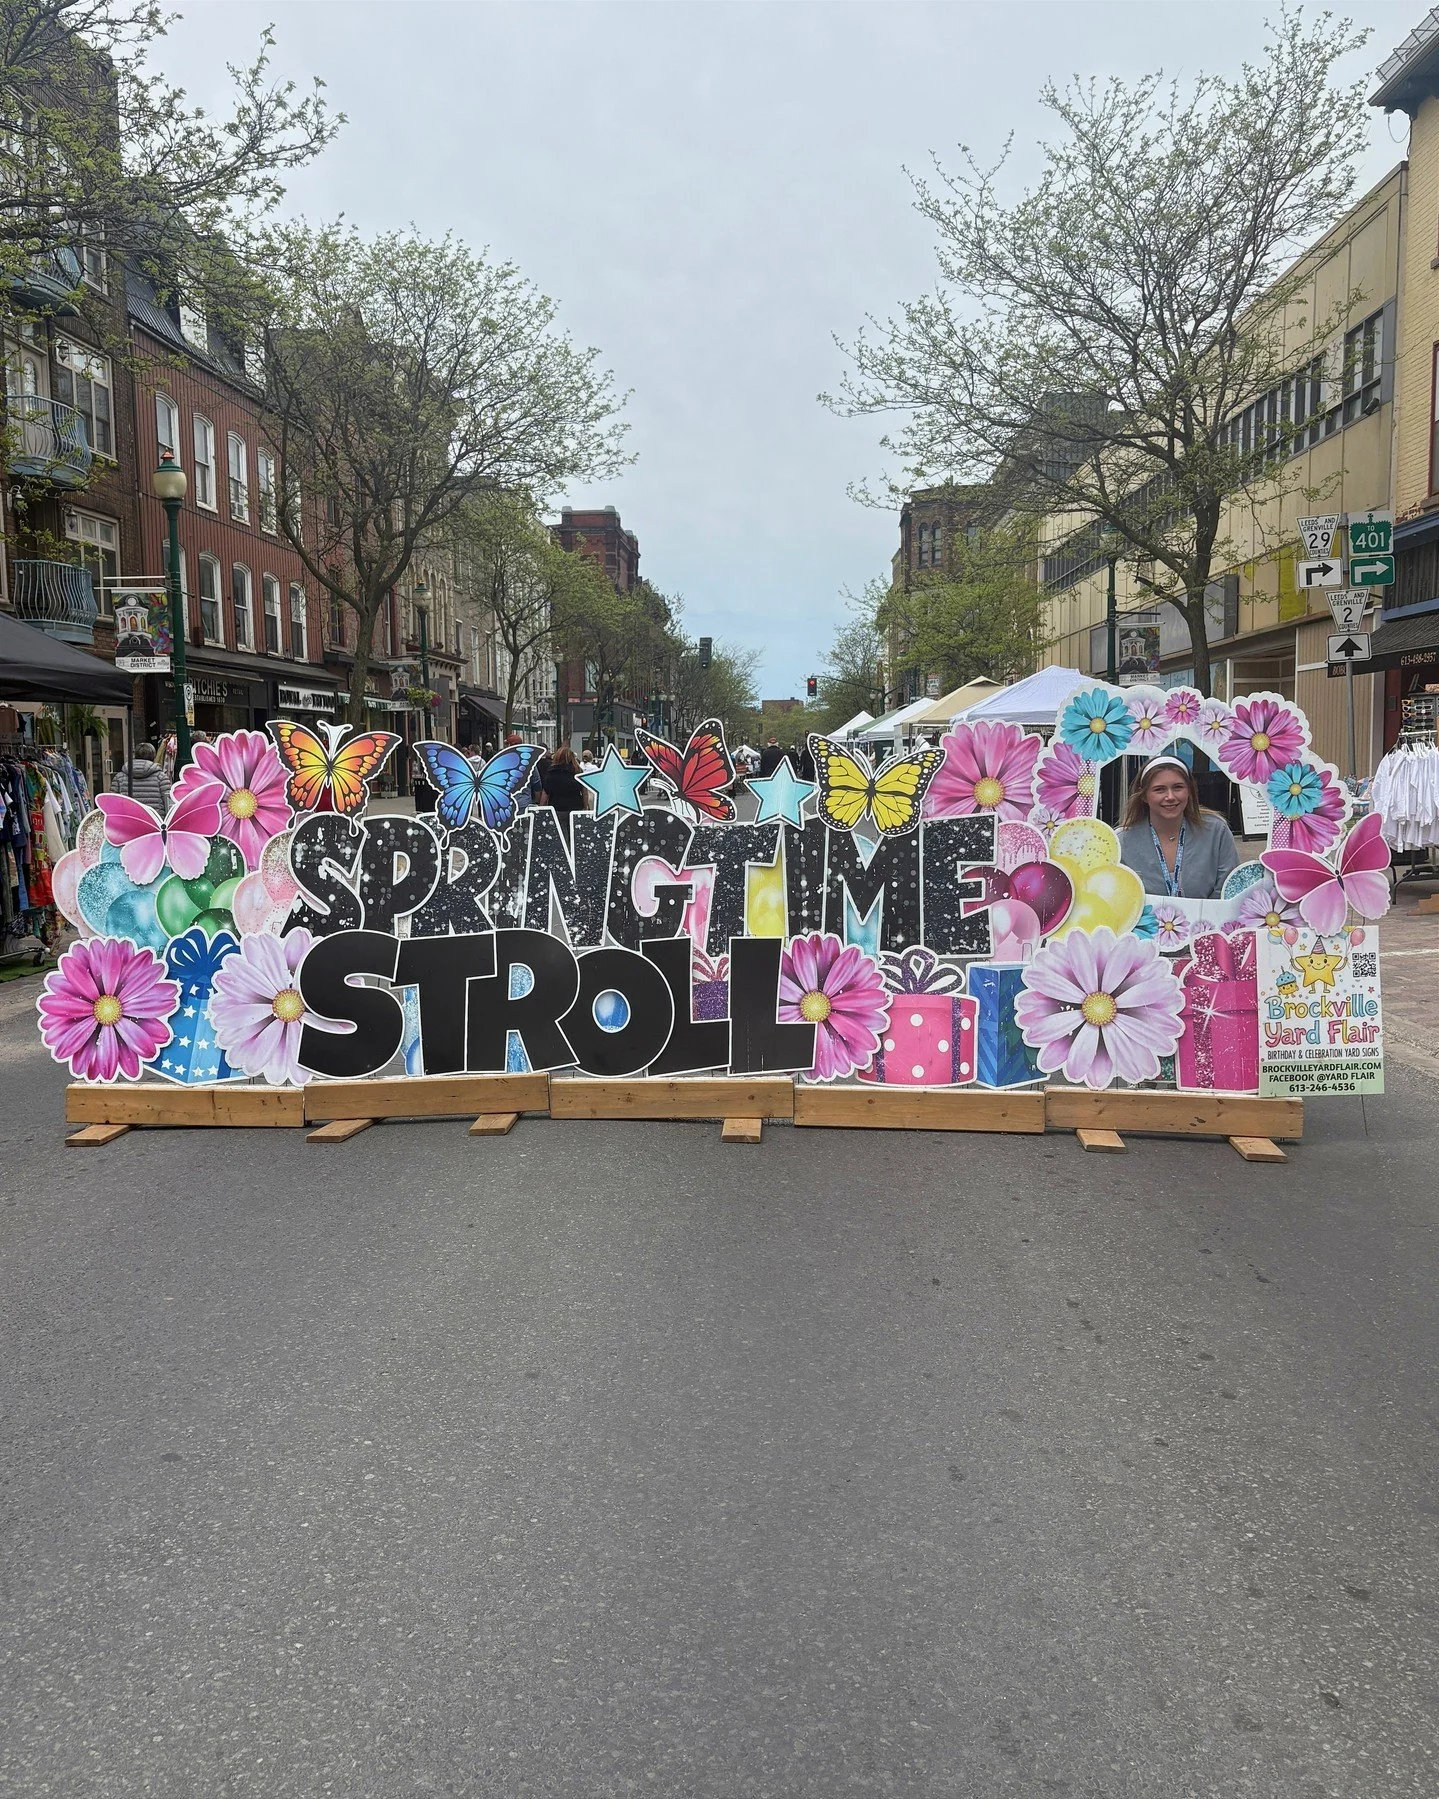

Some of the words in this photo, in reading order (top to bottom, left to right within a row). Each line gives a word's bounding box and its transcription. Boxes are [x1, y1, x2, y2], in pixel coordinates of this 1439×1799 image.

[1303, 524, 1333, 532] GRENVILLE
[1308, 532, 1330, 549] 29
[1356, 532, 1385, 549] 401
[1310, 548, 1330, 556] COUNTIES
[1343, 607, 1353, 623] 2
[298, 928, 817, 1077] STROLL
[1264, 994, 1378, 1020] Brockville
[1265, 1020, 1321, 1048] Yard
[1328, 1019, 1380, 1045] Flair
[1268, 1051, 1296, 1060] BIRTHDAY
[1298, 1050, 1303, 1059] &
[1306, 1049, 1343, 1059] CELEBRATION
[1345, 1049, 1360, 1058] YARD
[1363, 1048, 1379, 1057] SIGNS
[1262, 1062, 1381, 1074] BROCKVILLEYARDFLAIR.COM
[1269, 1074, 1315, 1082] FACEBOOK
[1317, 1073, 1349, 1082] @YARD
[1351, 1072, 1375, 1080] FLAIR
[1289, 1082, 1355, 1092] 613-246-4536
